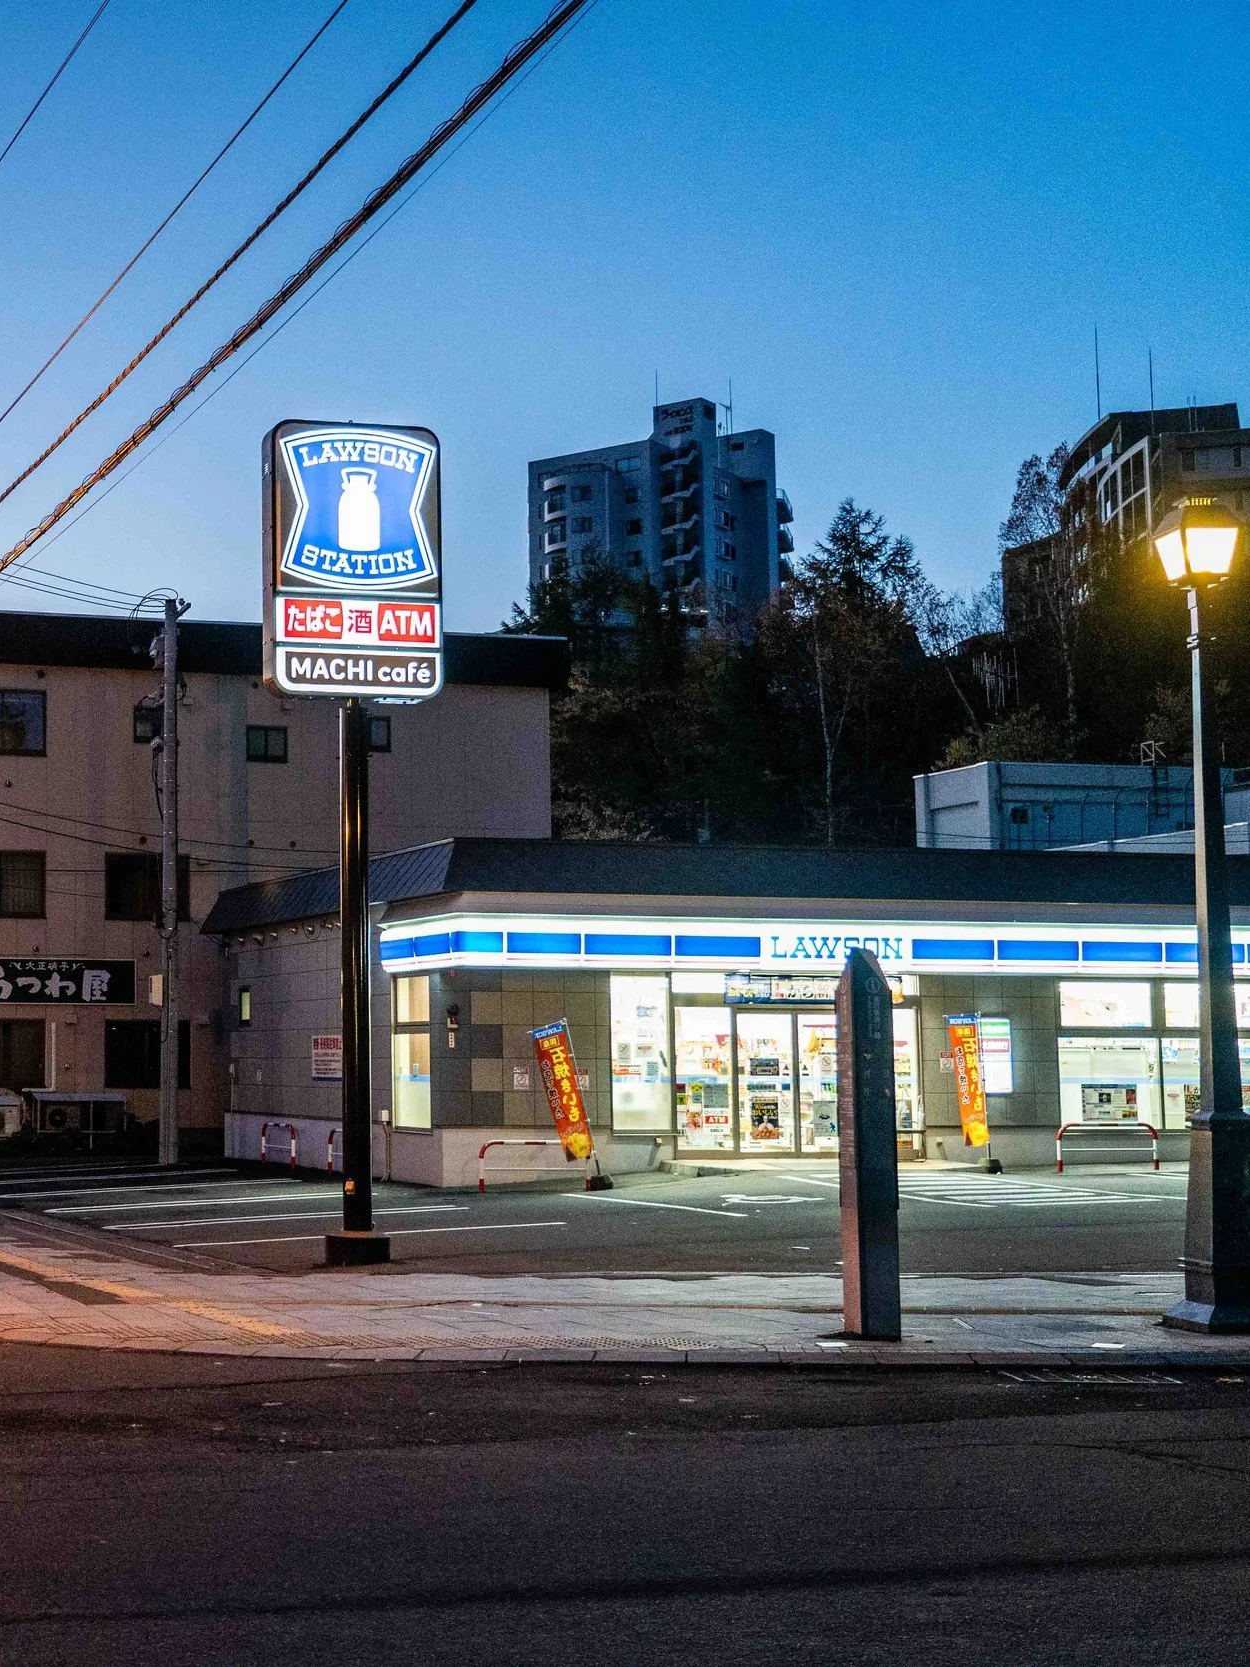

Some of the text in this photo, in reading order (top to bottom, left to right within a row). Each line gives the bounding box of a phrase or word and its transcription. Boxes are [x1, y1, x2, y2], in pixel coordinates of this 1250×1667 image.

[298, 441, 419, 474] LAWSON
[301, 545, 418, 575] STATION
[286, 604, 433, 637] たばこ 酒 ATM
[290, 657, 432, 684] MACHI café
